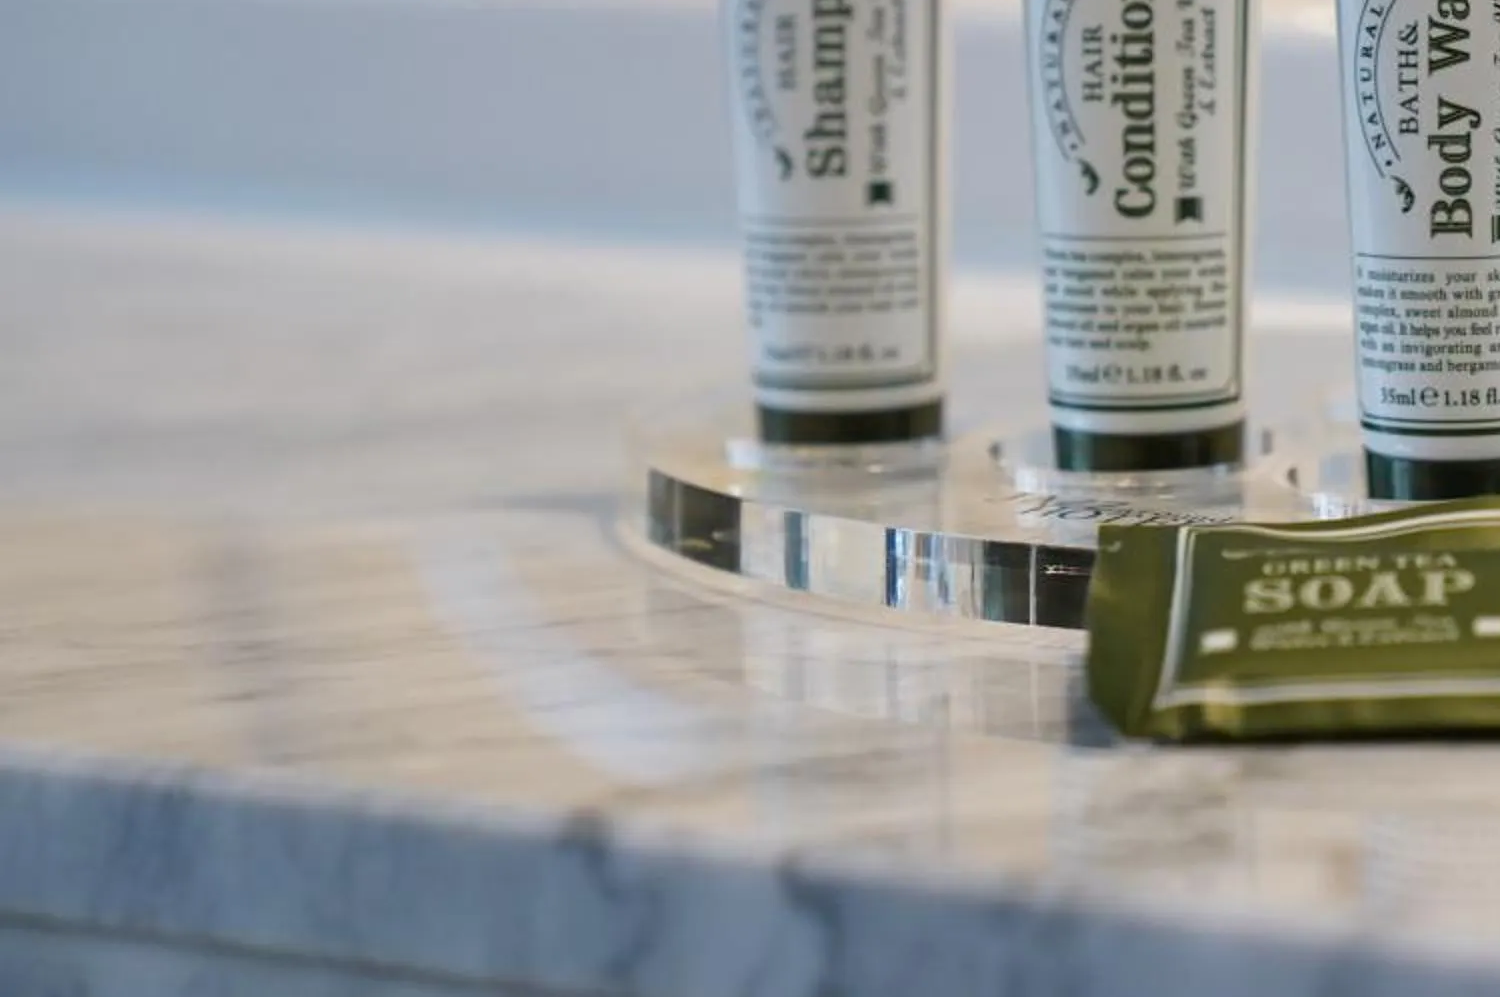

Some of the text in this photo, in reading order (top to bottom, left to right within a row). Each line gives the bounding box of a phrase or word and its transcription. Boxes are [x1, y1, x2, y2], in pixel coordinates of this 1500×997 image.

[1082, 24, 1104, 103] HAIR
[1359, 5, 1387, 150] NATURAL
[1398, 19, 1419, 135] BATH&
[1428, 94, 1482, 239] Body
[1446, 271, 1476, 286] your
[1452, 287, 1482, 300] with
[1405, 306, 1441, 318] sweet
[1447, 305, 1498, 318] almond
[1410, 324, 1440, 338] helps
[1443, 327, 1466, 339] you
[1470, 323, 1492, 335] feel
[1401, 341, 1482, 357] invigorating
[1420, 359, 1443, 371] and
[1381, 387, 1415, 406] 35ml
[1444, 390, 1481, 407] 1.18
[1242, 569, 1476, 614] SOAP
